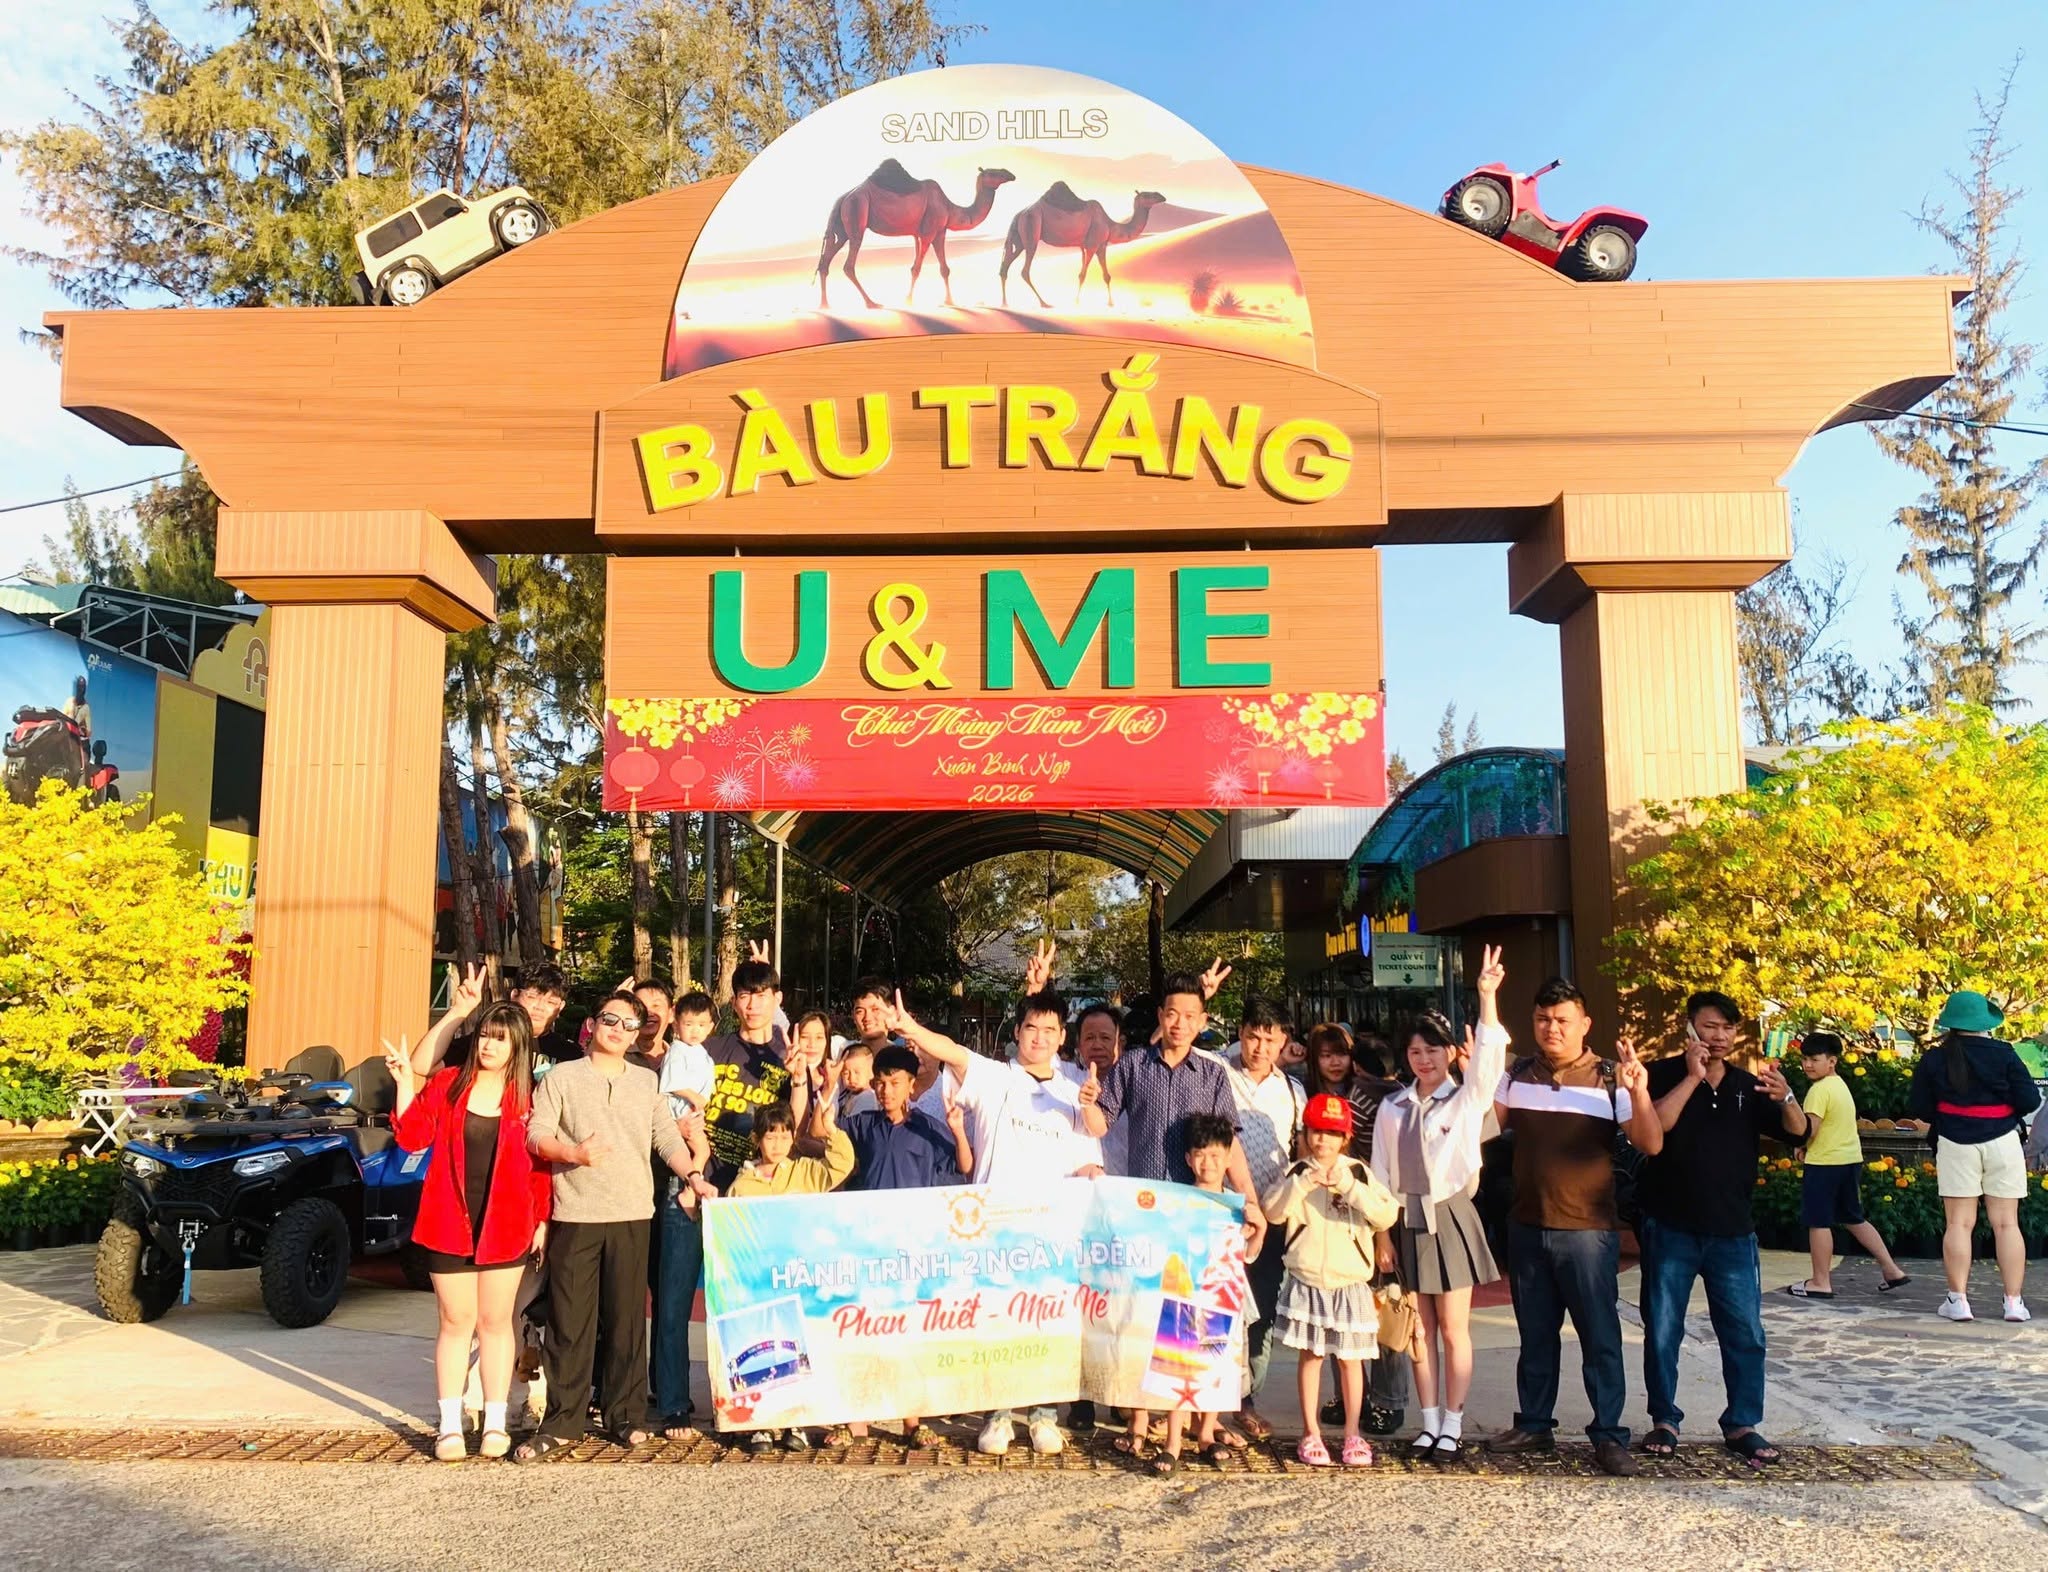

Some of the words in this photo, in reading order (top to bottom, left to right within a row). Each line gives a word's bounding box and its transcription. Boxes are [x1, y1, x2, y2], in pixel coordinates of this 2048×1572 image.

[881, 111, 989, 143] SAND
[997, 109, 1109, 139] HILLS
[634, 389, 892, 513] BÀU
[916, 354, 1353, 502] TRẮNG
[841, 704, 918, 748] Chúc
[894, 703, 1008, 750] Mừng
[1058, 704, 1167, 748] Mới
[932, 755, 976, 778] Xuân
[981, 752, 1029, 776] Bính
[1029, 752, 1071, 784] Ngọ
[967, 784, 1037, 803] 2026
[771, 1256, 857, 1289] HÀNH
[863, 1249, 952, 1285] TRÌNH
[964, 1249, 980, 1276] 2
[986, 1239, 1067, 1274] NGÀY
[1090, 1234, 1152, 1268] ĐÊM
[832, 1304, 909, 1339] Phan
[916, 1292, 982, 1333] Thiết
[1007, 1289, 1068, 1330] Mũi
[1073, 1283, 1112, 1328] Né
[937, 1353, 954, 1369] 20
[972, 1343, 1049, 1366] 21/02/2026
